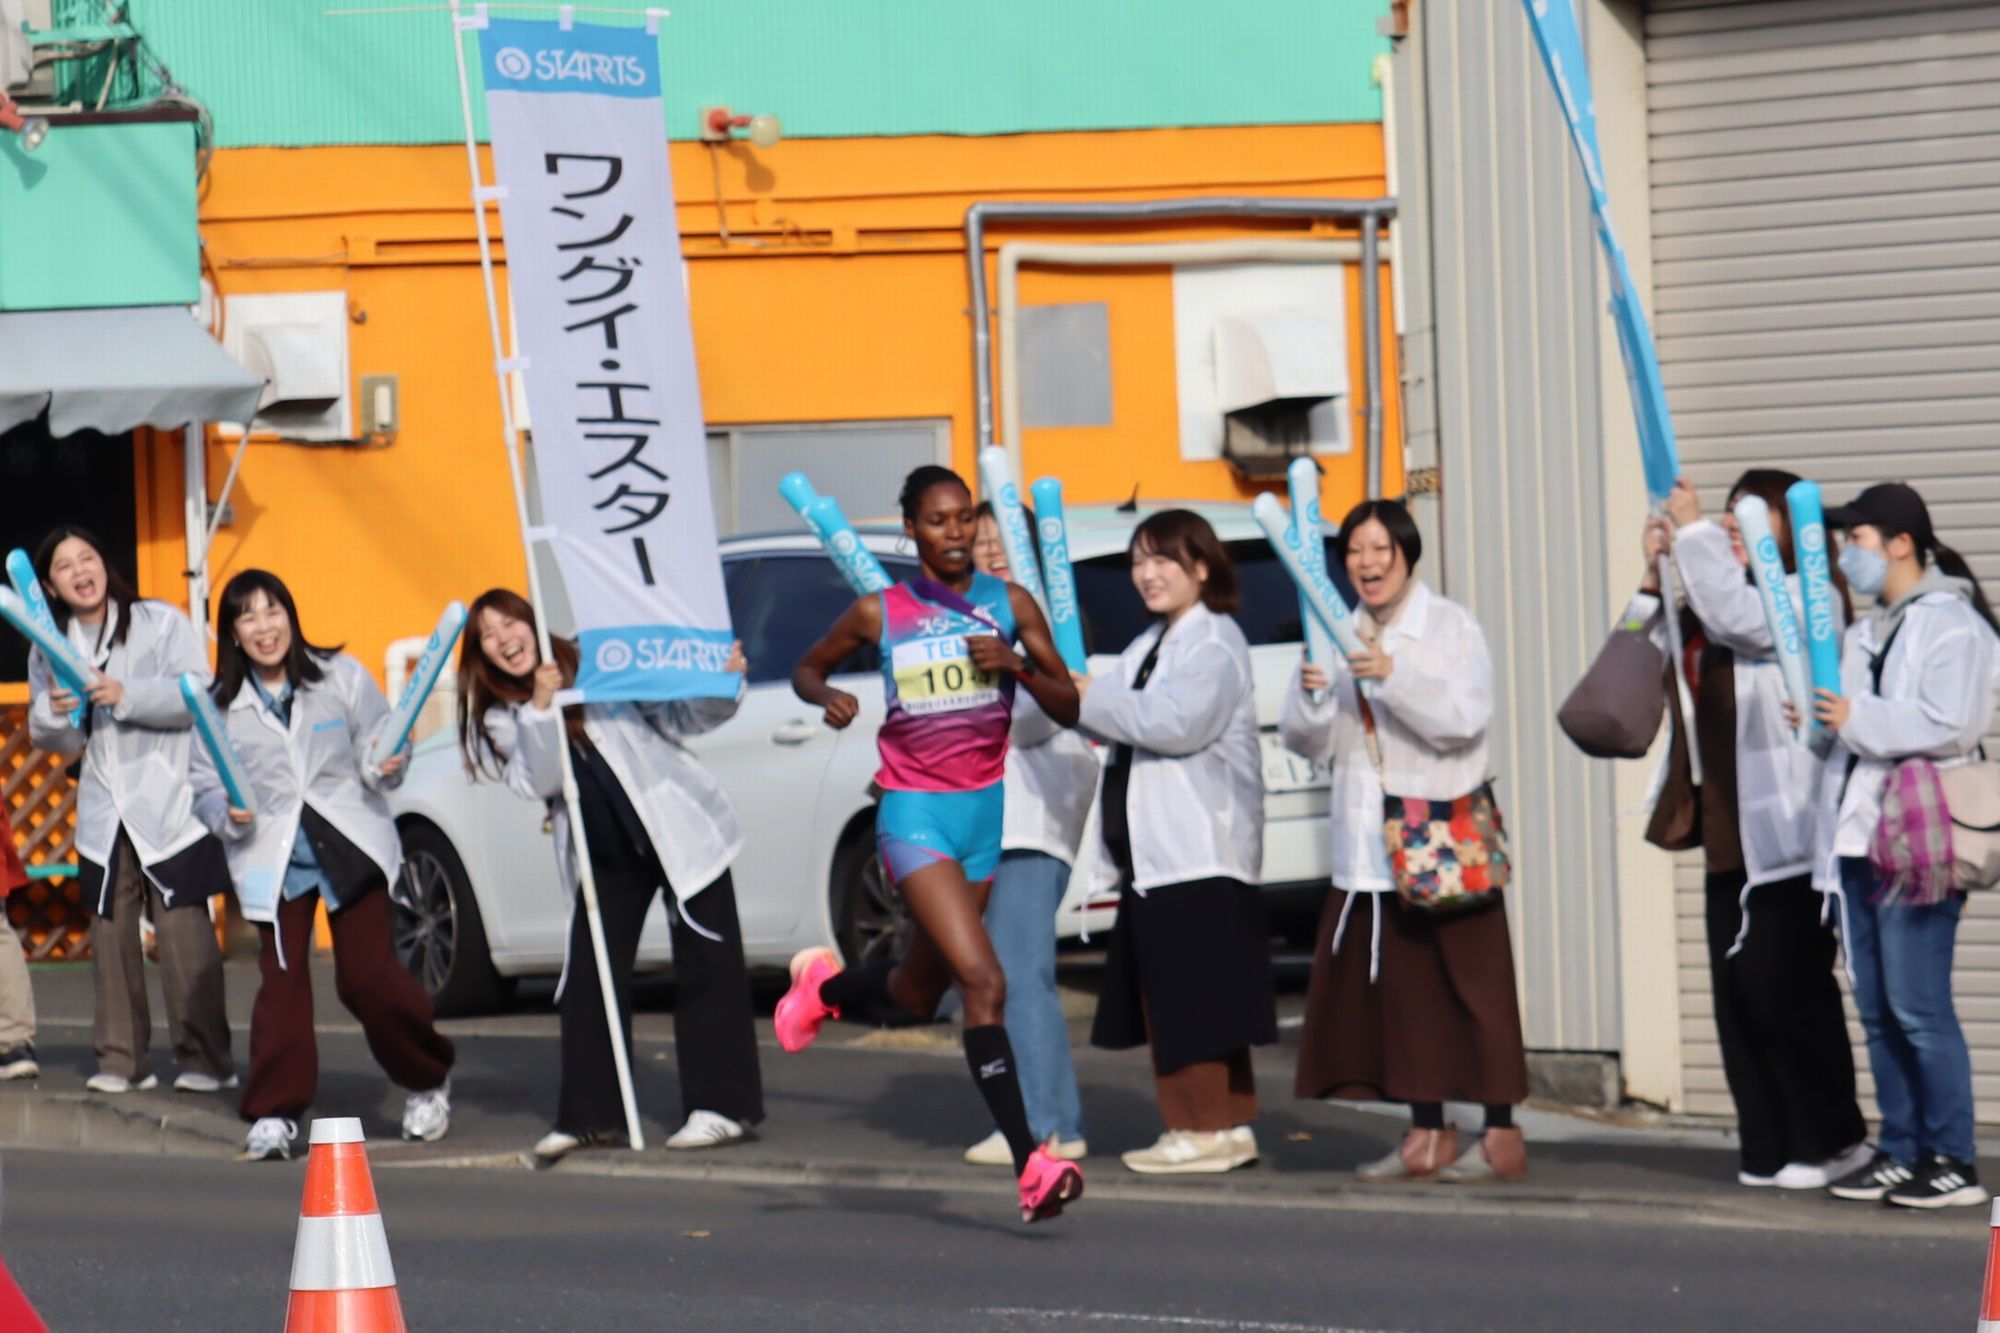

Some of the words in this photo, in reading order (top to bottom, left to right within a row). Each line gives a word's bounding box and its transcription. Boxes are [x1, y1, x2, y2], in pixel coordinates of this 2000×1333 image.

[545, 153, 669, 586] ワングイ・エスター
